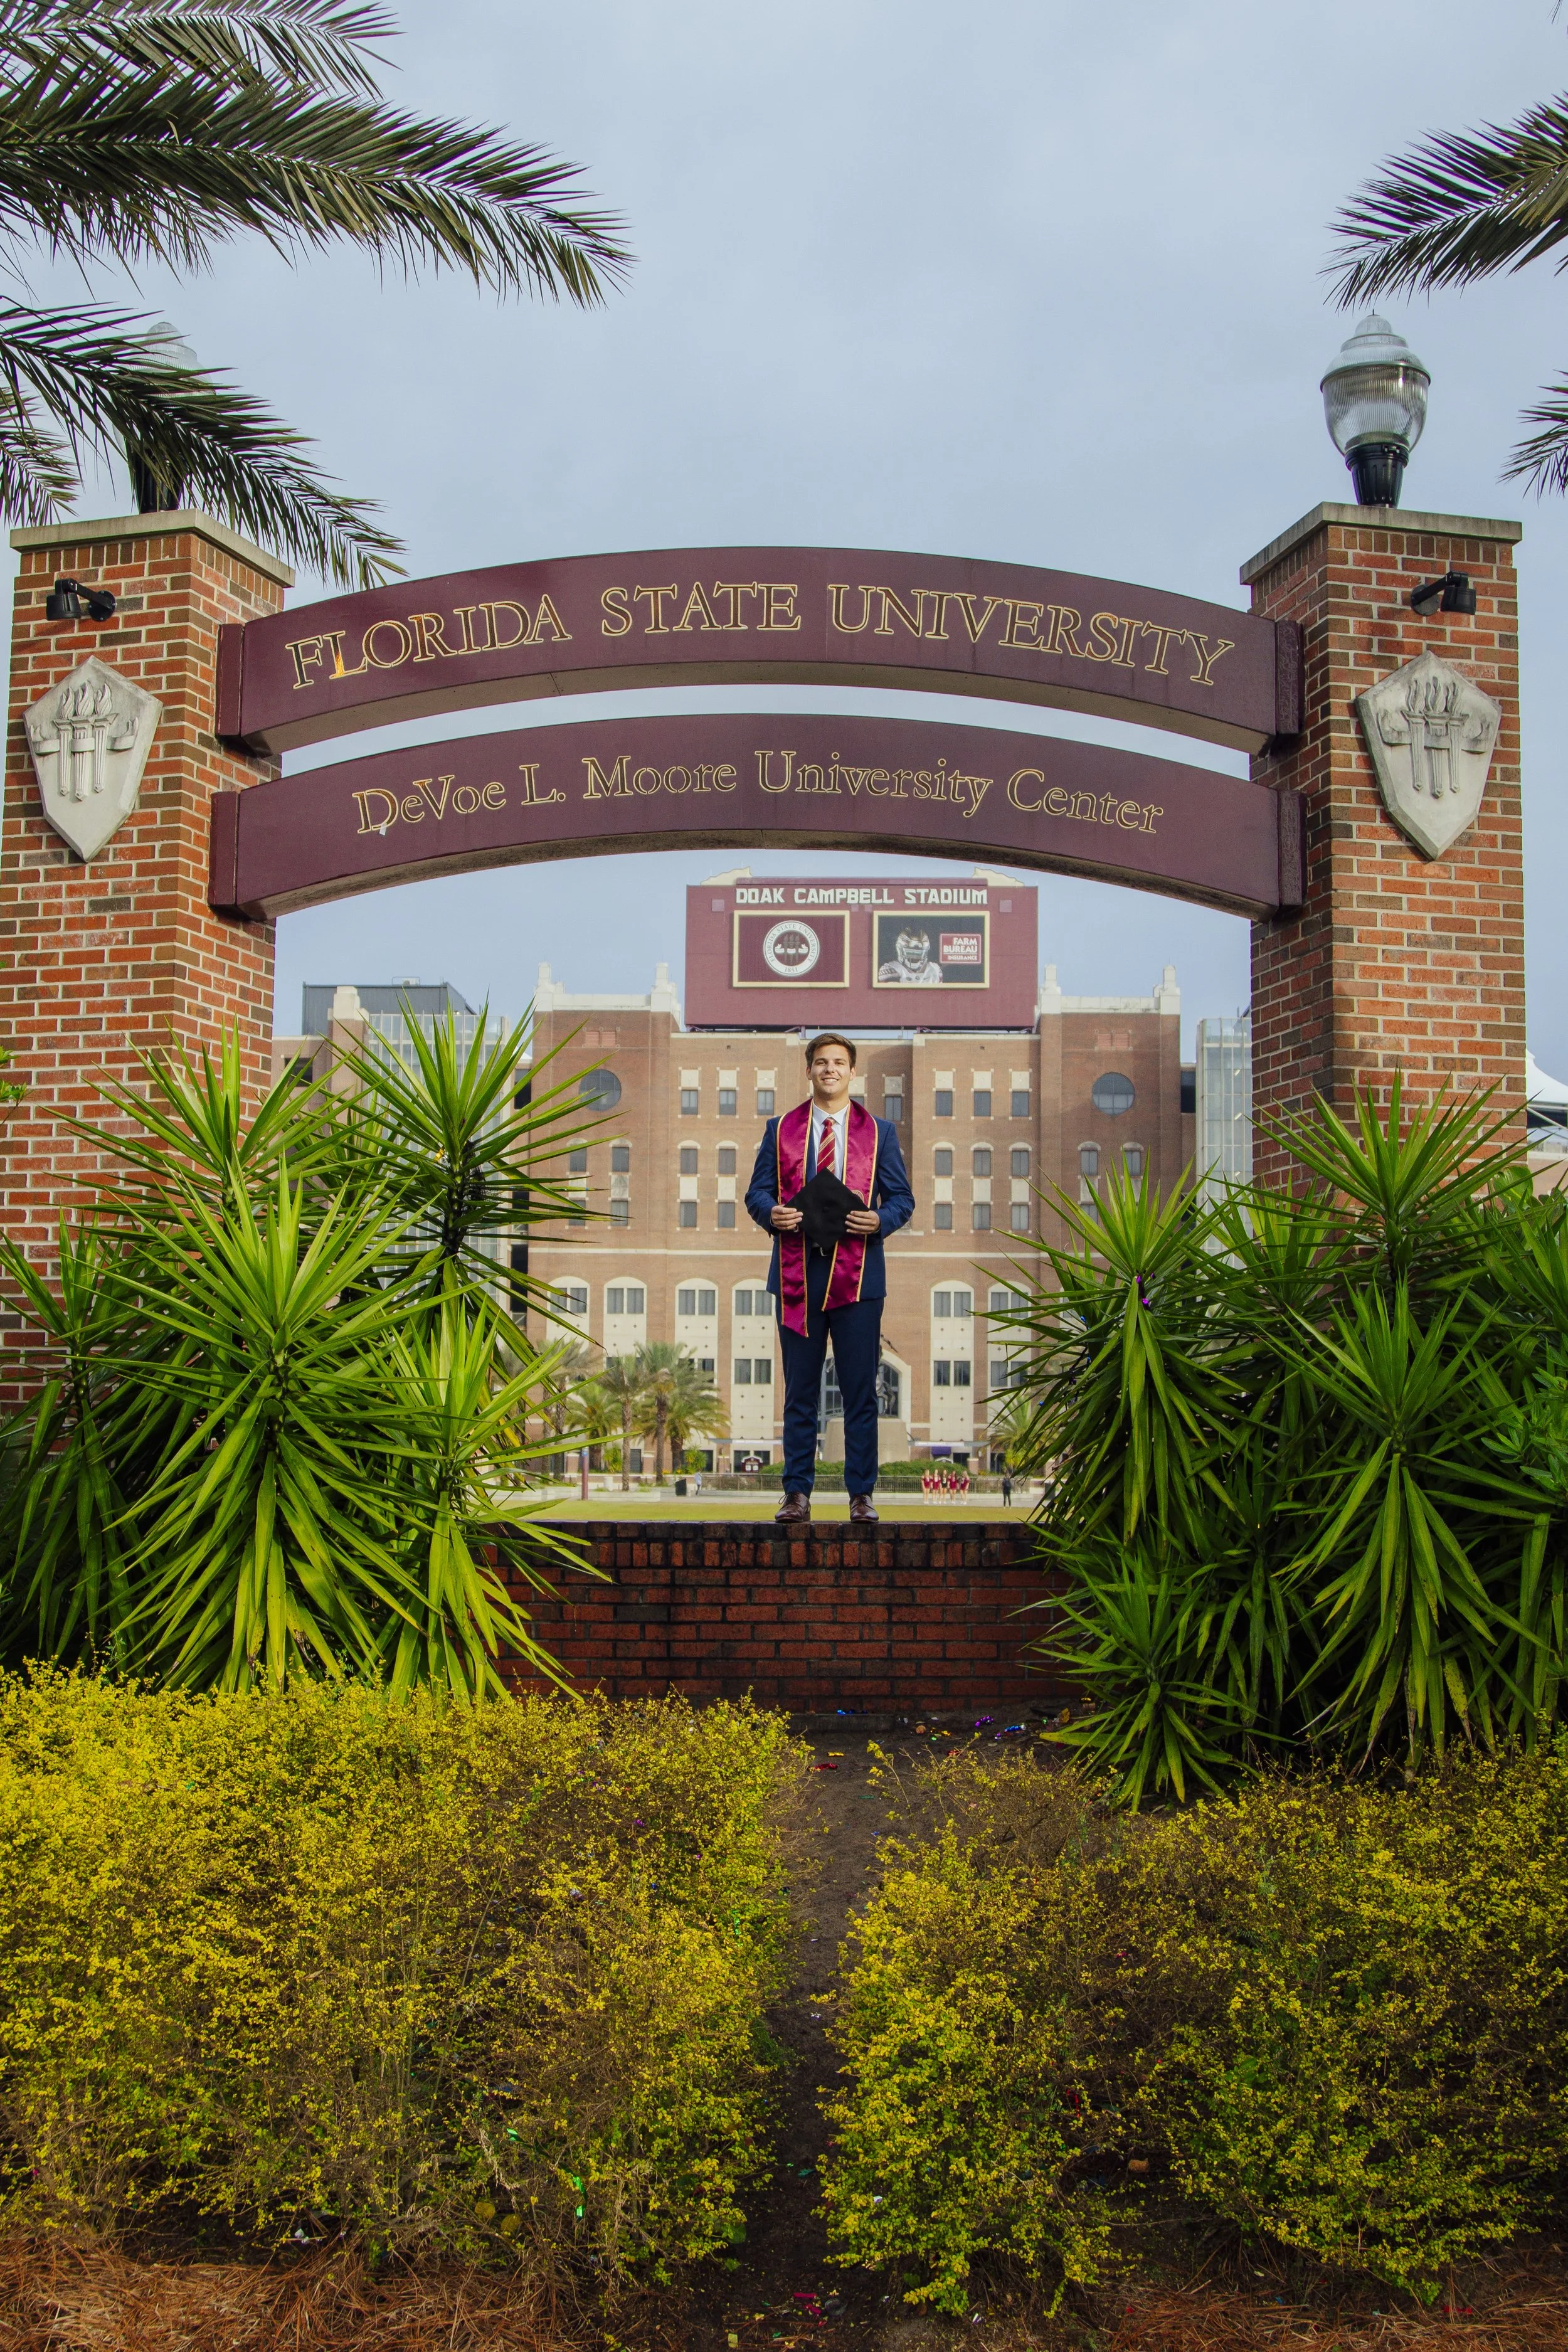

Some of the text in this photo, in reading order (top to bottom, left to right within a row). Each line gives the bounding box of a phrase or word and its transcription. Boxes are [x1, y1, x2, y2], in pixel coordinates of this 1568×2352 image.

[285, 581, 1235, 689] FLORIDA STATE UNIVERSITY
[352, 751, 1163, 834] DeVoe L. Moore University Center
[736, 888, 988, 904] DOAK CAMPBELL STADIUM
[766, 923, 816, 963] FLORIDA STATE UNIVERSITY
[943, 945, 978, 953] BUREAU
[953, 937, 978, 945] FARM
